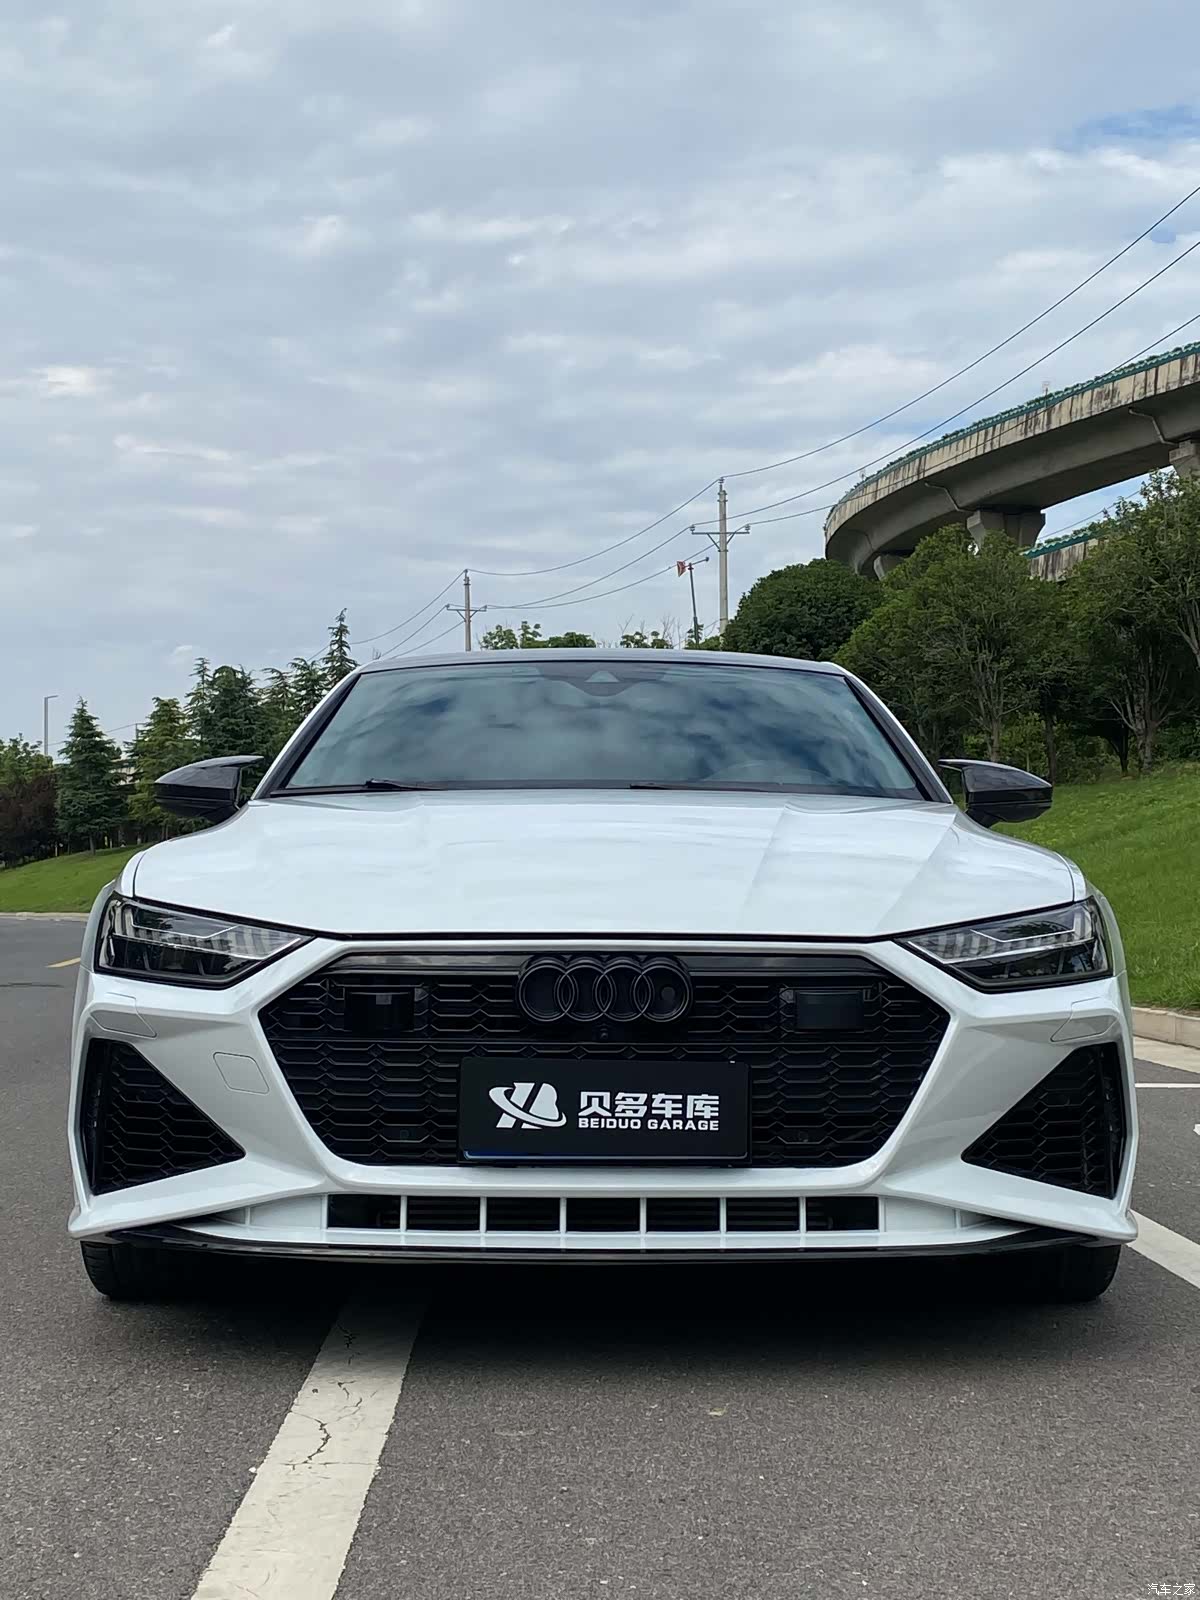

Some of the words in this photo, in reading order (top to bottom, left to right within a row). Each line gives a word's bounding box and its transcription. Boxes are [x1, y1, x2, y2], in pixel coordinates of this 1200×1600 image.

[578, 1091, 719, 1118] 贝多车库
[578, 1118, 641, 1130] BEIDUO
[647, 1119, 719, 1131] GARAGE
